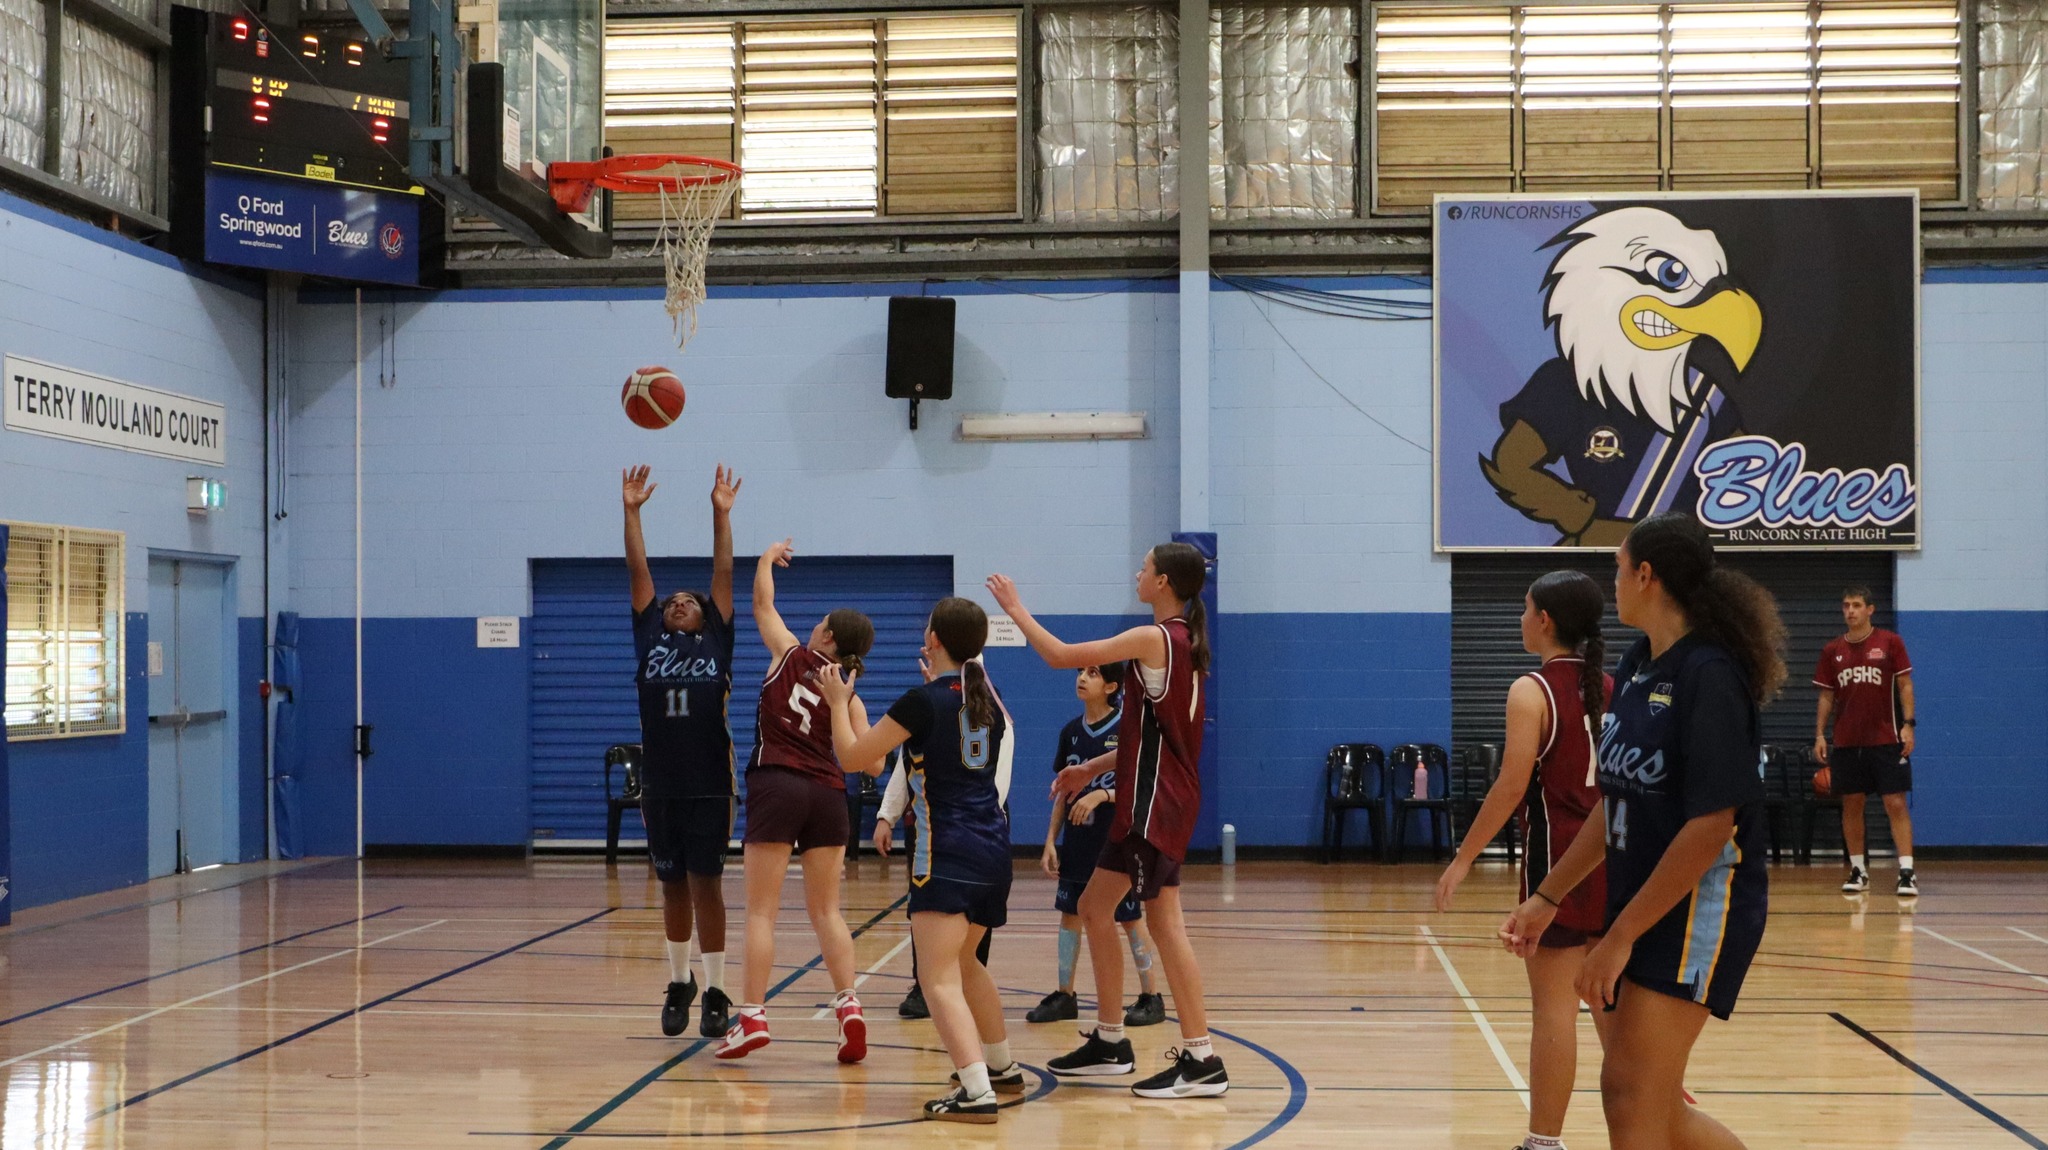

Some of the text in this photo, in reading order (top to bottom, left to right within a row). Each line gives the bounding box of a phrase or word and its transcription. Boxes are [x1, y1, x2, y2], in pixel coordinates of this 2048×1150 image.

[238, 195, 284, 216] Q Ford
[220, 214, 302, 239] Springwood
[328, 220, 369, 246] Blues
[14, 375, 219, 449] TERRY MOULAND COURT
[1695, 436, 1915, 528] Blues
[1729, 528, 1887, 541] RUNCORN STATE HIGH
[645, 645, 718, 679] Blues
[666, 688, 690, 717] 11
[958, 703, 990, 770] 8
